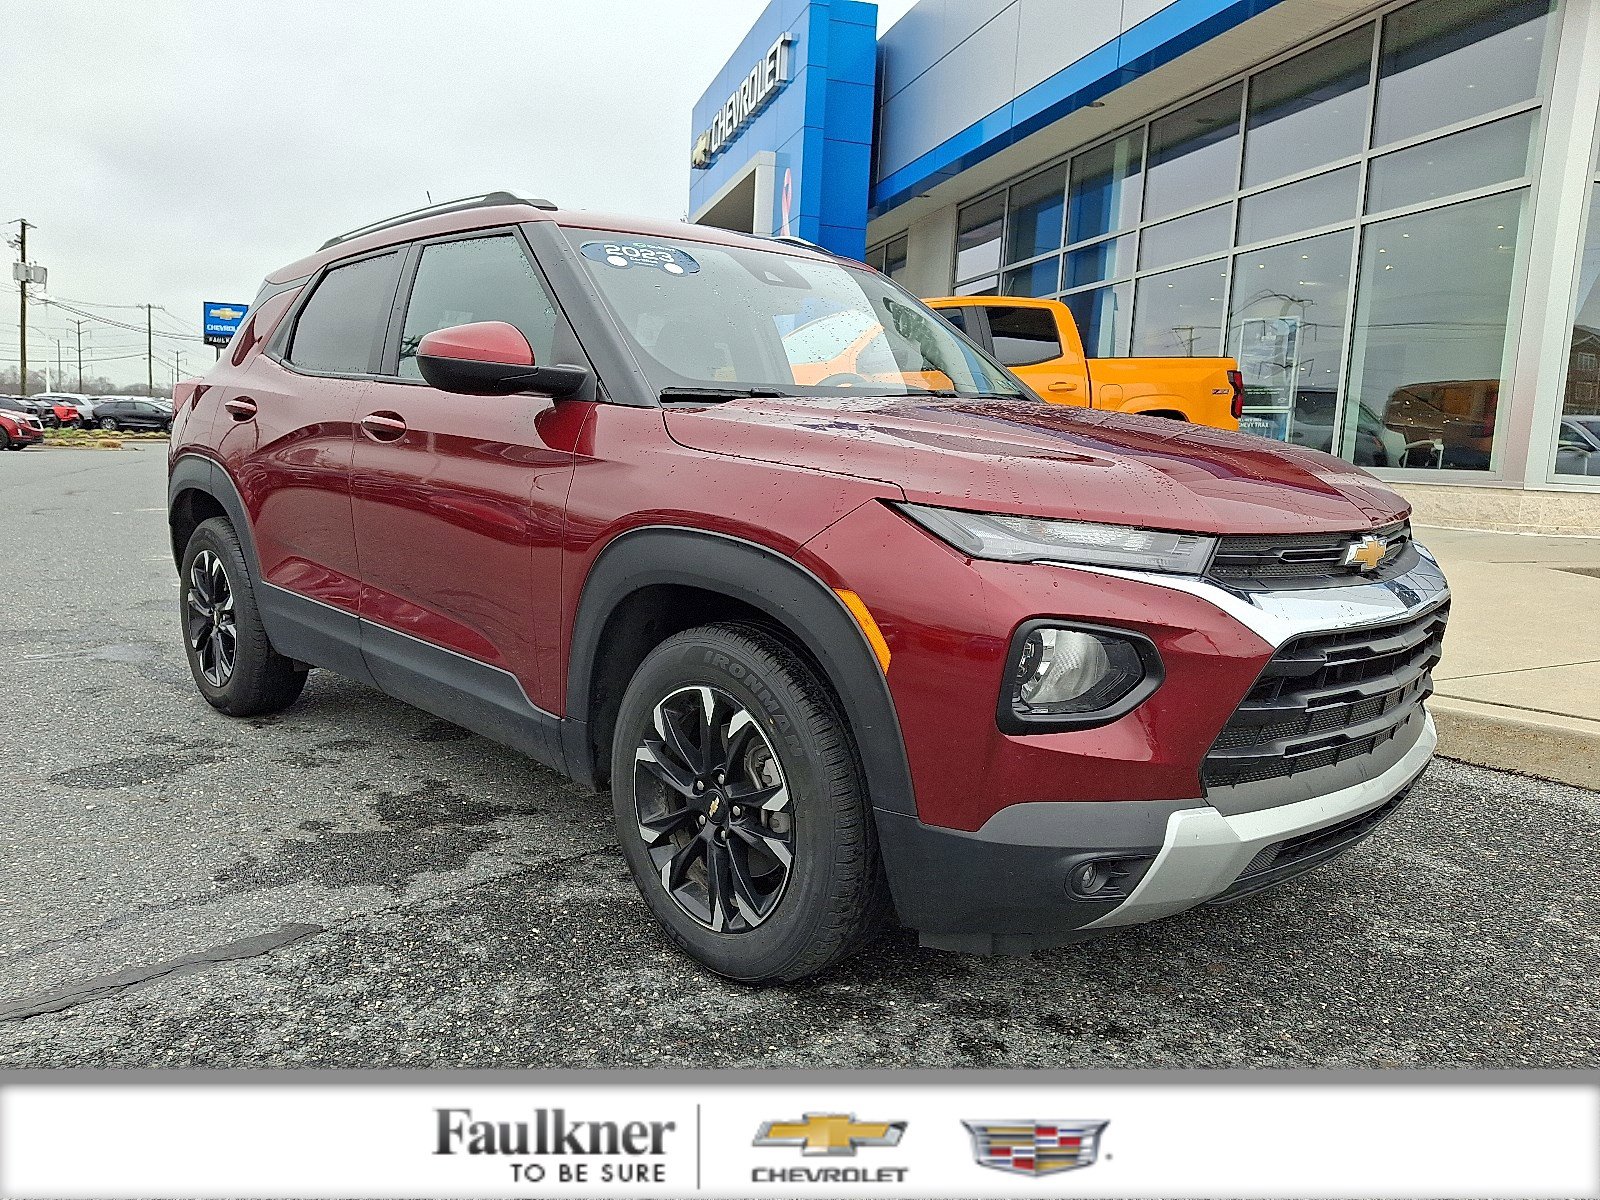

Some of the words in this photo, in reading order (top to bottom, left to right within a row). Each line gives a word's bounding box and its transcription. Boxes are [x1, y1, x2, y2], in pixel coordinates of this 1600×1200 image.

[711, 32, 798, 155] CHEVROLET
[603, 244, 675, 262] 2023
[704, 650, 803, 757] IRONMAN
